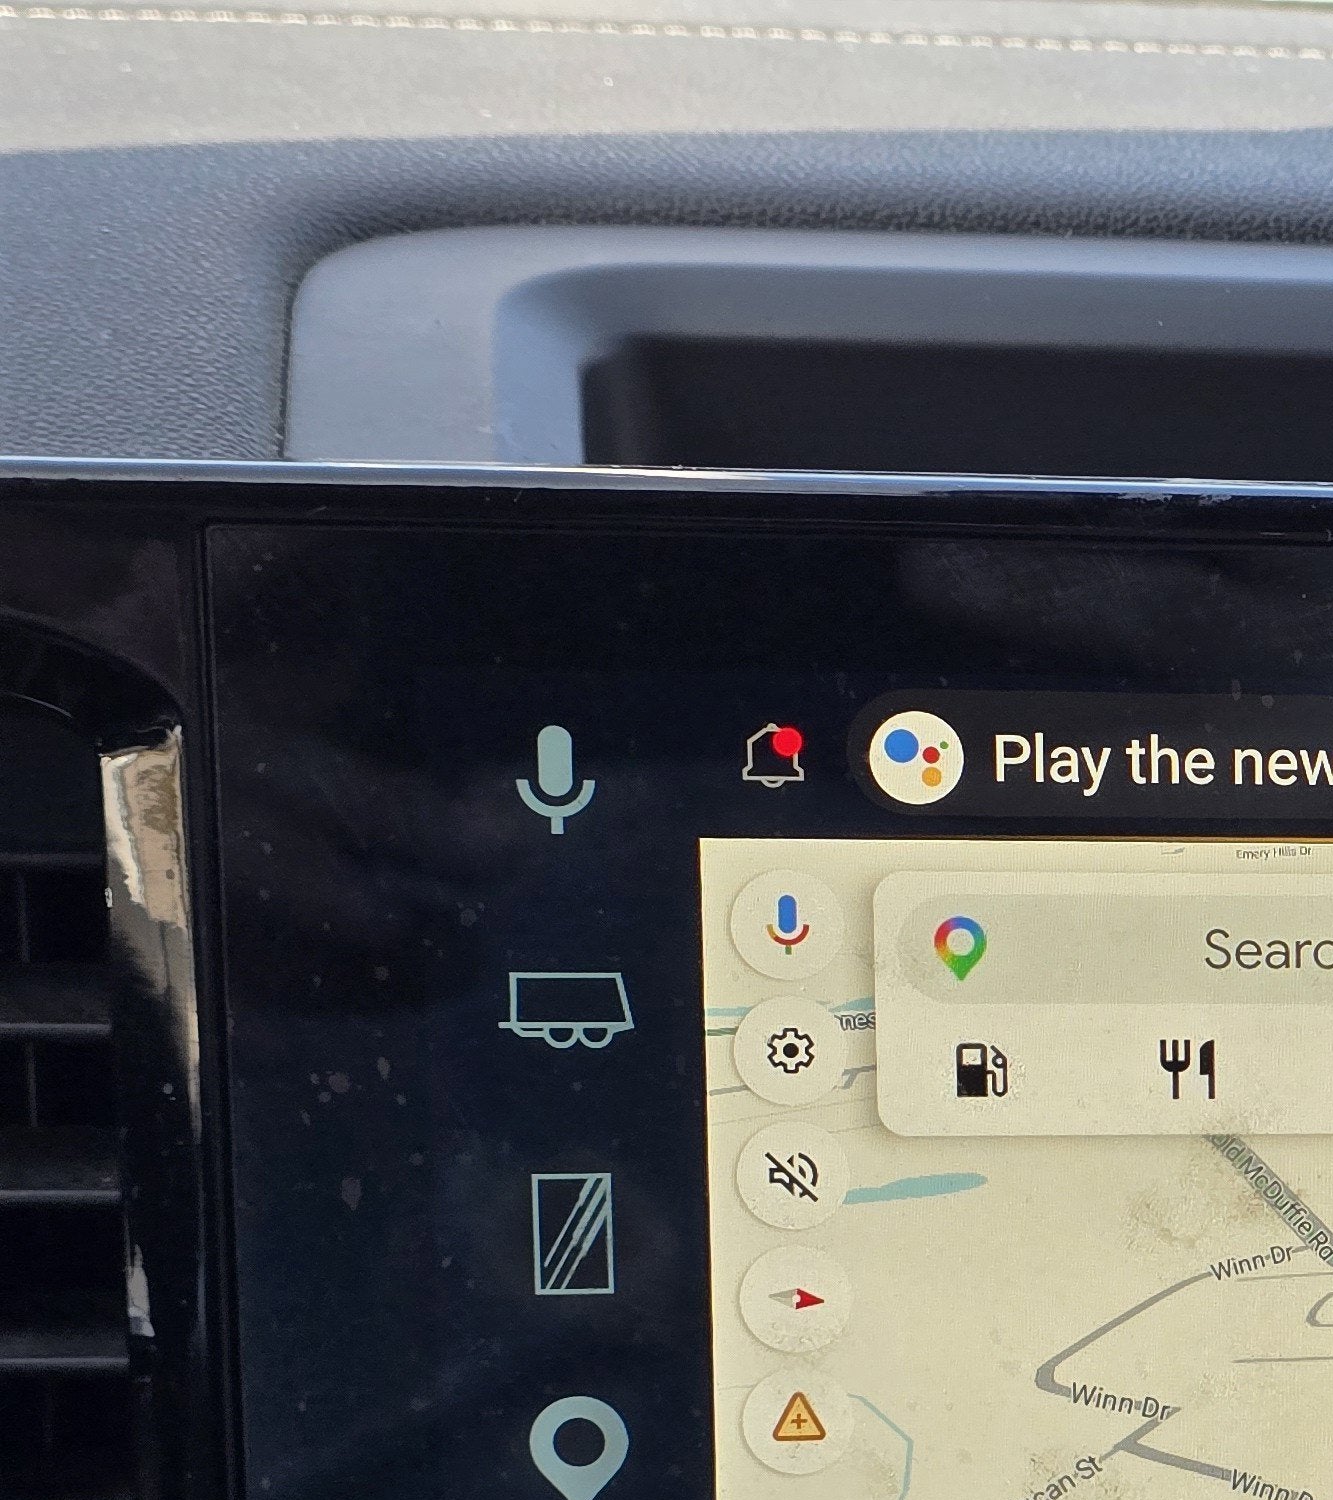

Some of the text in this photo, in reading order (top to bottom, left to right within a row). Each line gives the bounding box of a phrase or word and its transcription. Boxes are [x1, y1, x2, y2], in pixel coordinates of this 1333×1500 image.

[994, 732, 1111, 797] Play
[1126, 733, 1215, 785] the
[1240, 1155, 1312, 1236] McDuffie
[1209, 1245, 1293, 1281] Winn Dr
[1071, 1381, 1170, 1420] Winn Dr
[1075, 1455, 1103, 1480] St
